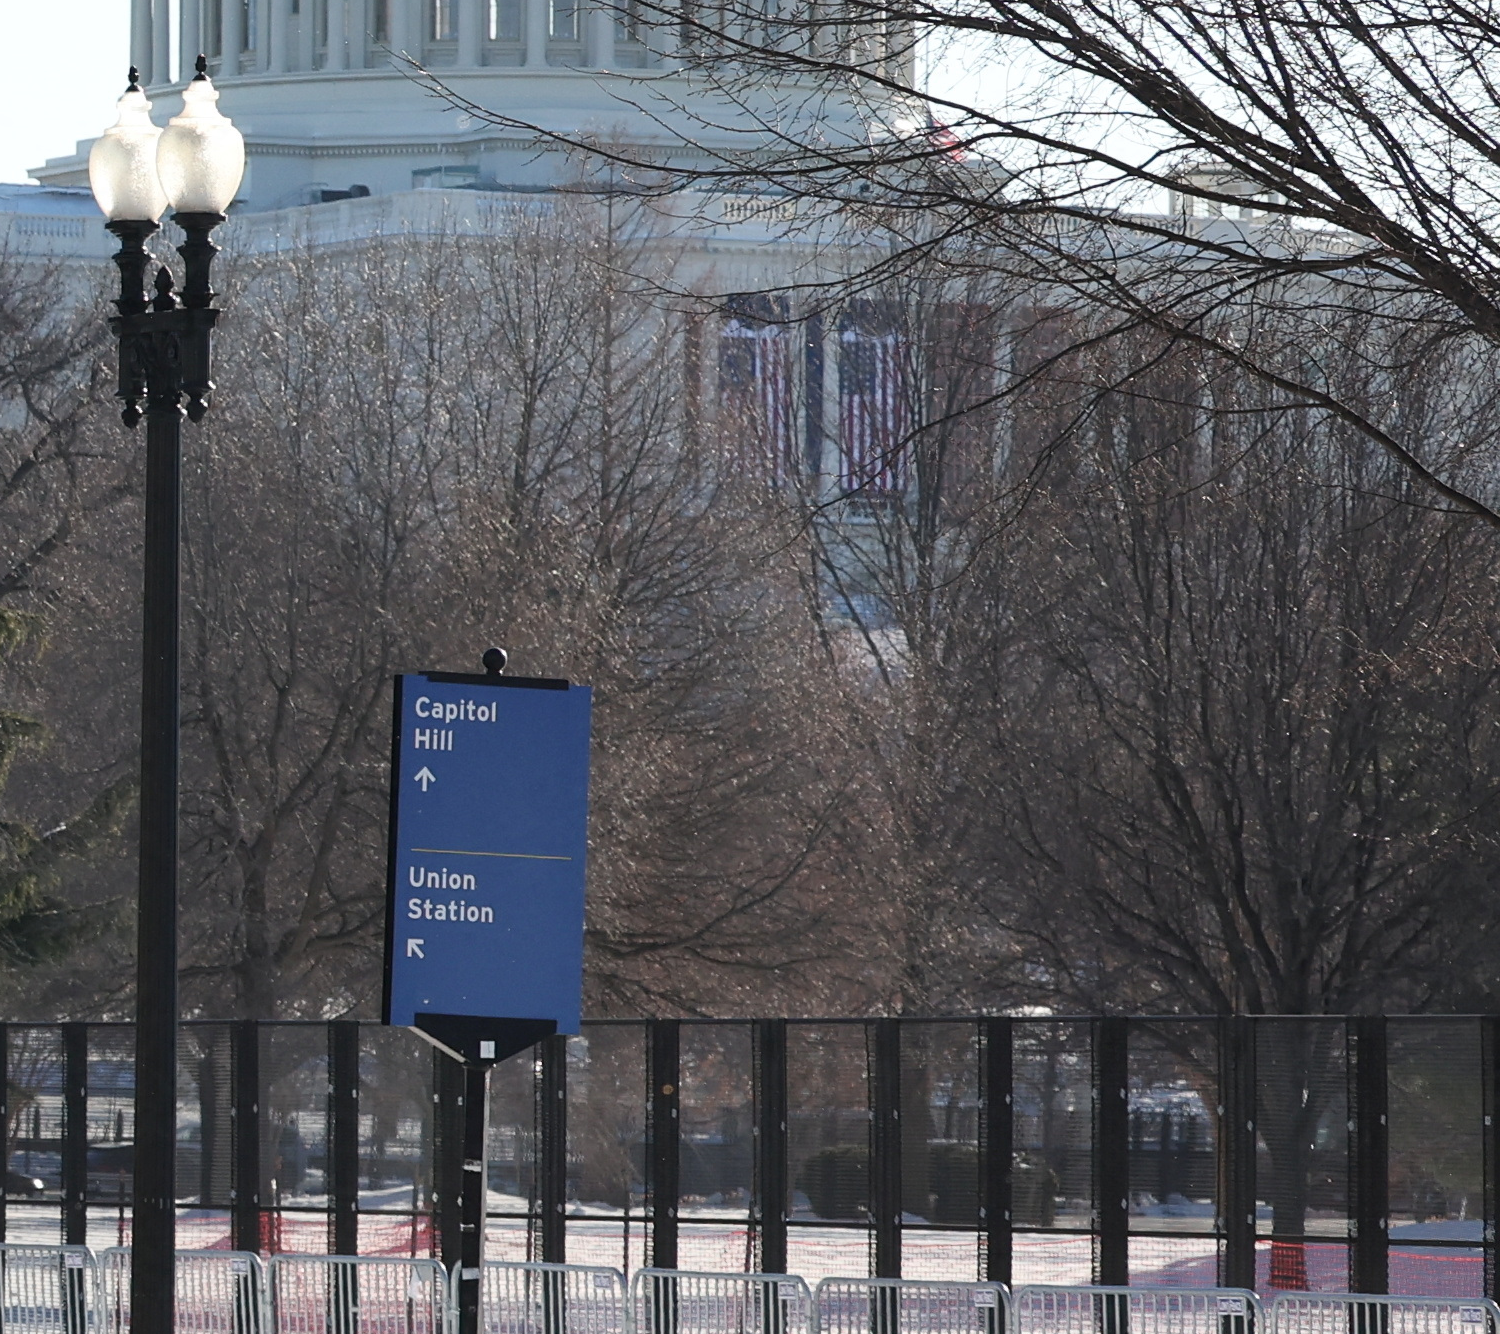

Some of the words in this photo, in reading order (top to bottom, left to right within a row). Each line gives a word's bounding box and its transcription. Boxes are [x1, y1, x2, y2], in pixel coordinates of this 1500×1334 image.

[415, 696, 497, 724] Capitol
[414, 728, 453, 751] Hill
[409, 866, 476, 890] Union
[407, 898, 494, 924] Station
